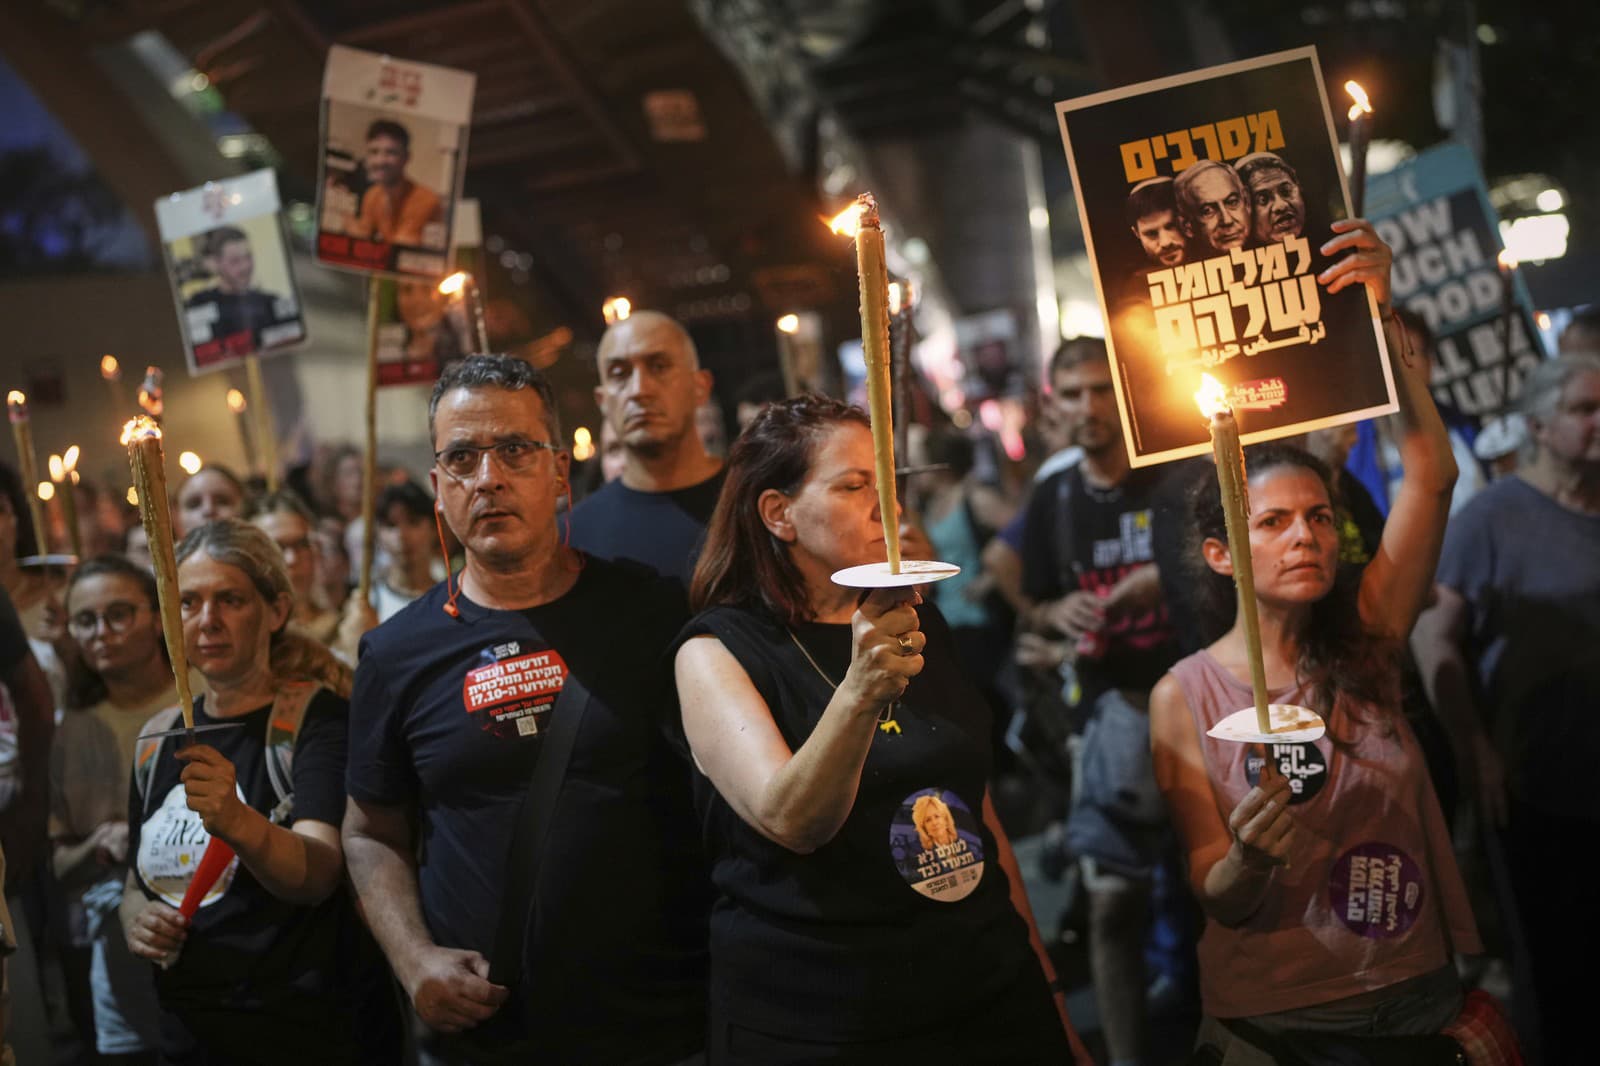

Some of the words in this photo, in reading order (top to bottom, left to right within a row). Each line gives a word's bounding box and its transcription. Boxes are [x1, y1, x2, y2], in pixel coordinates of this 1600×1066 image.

[1120, 110, 1286, 183] מסרבים
[1378, 202, 1453, 257] OW
[1147, 234, 1311, 308] למלחמה
[1389, 229, 1483, 296] UCH
[1152, 274, 1321, 354] שלהם
[1242, 321, 1326, 357] نرفض
[475, 665, 505, 683] ועדת
[505, 655, 549, 673] דורשים
[524, 665, 562, 681] חקירה
[467, 673, 522, 697] ממלכתית
[518, 676, 564, 694] לאירועי
[916, 850, 935, 865] לא
[934, 838, 968, 859] לעולם
[917, 861, 942, 879] לבד
[1348, 856, 1368, 921] מסרבים
